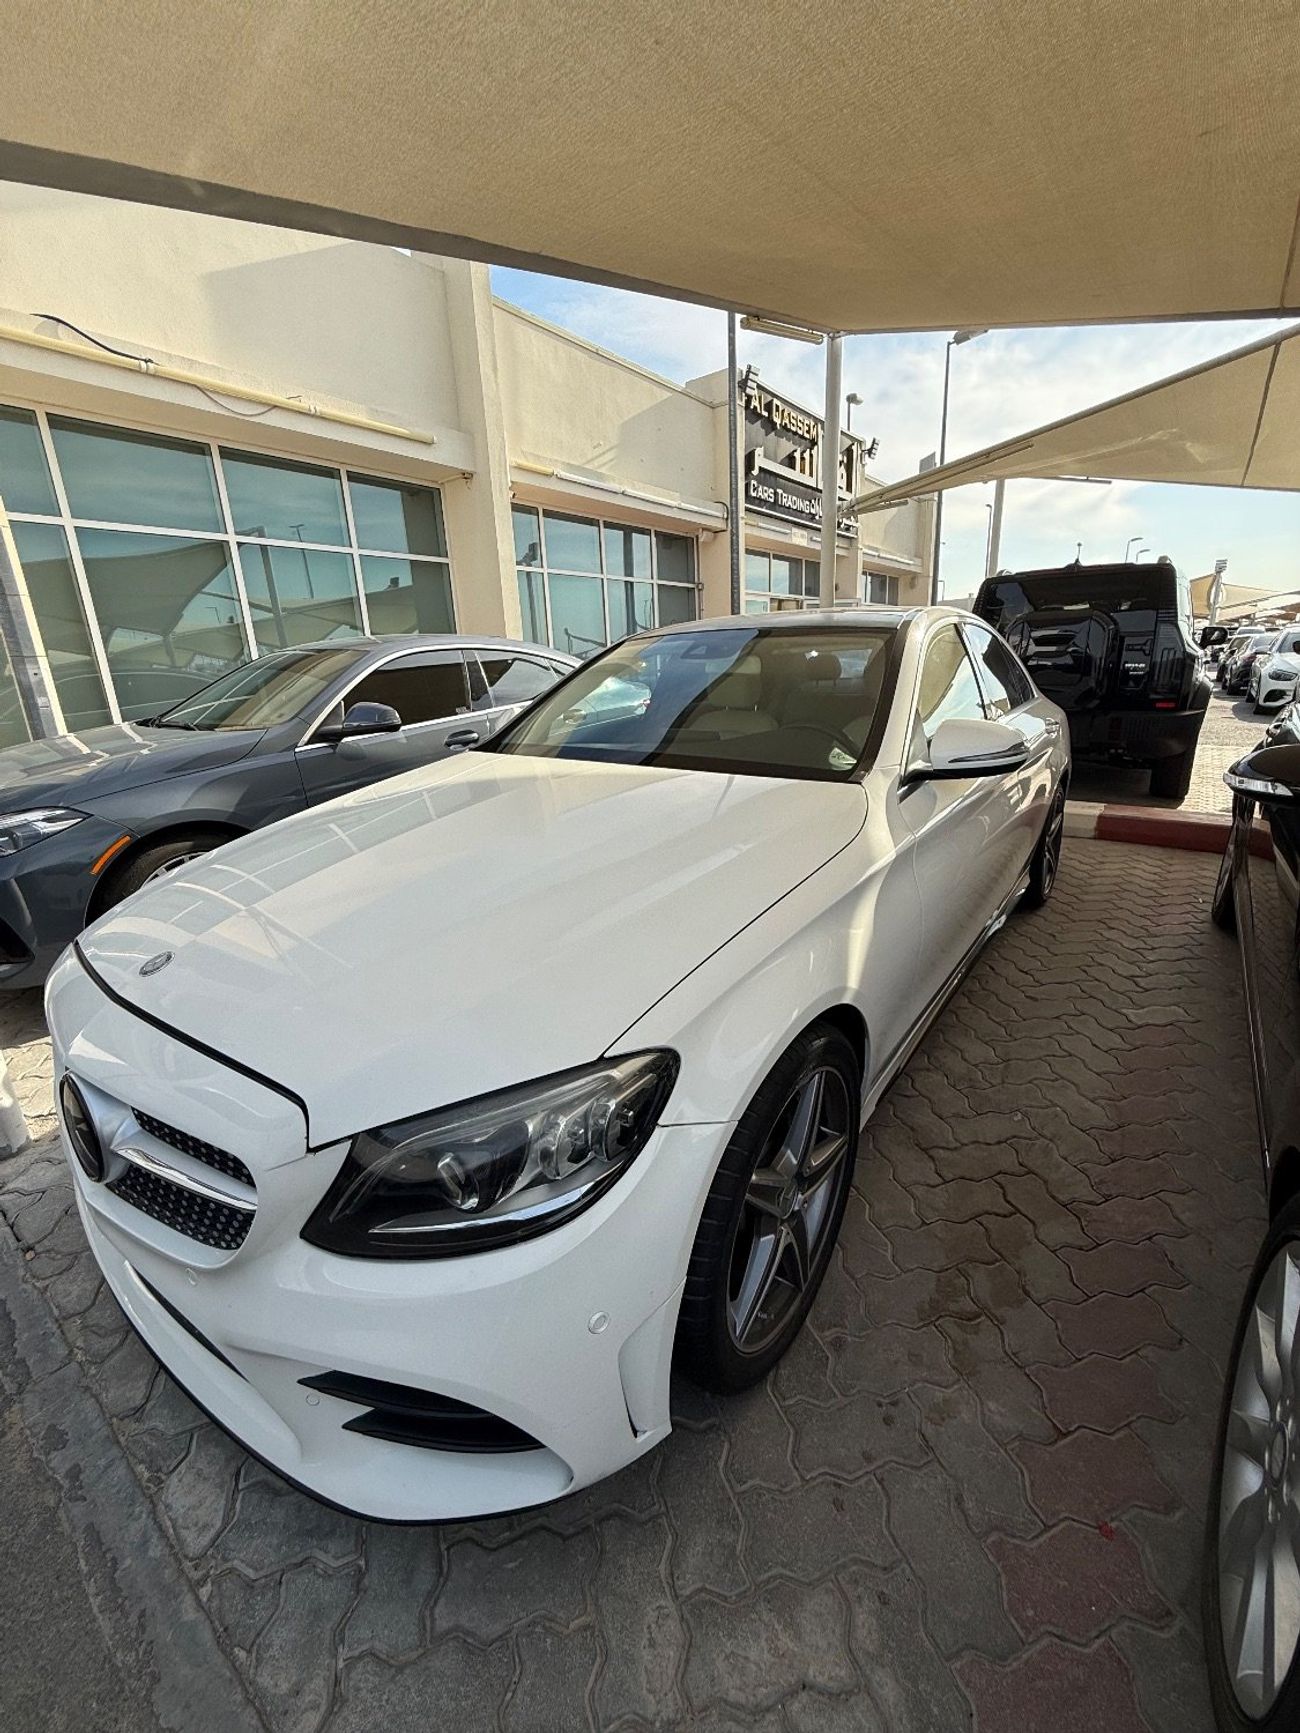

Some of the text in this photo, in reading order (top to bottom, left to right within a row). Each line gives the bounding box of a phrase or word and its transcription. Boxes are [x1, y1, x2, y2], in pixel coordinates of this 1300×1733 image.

[751, 385, 818, 442] AL QASSEM
[750, 479, 775, 502] CARS
[776, 488, 811, 513] TRADING
